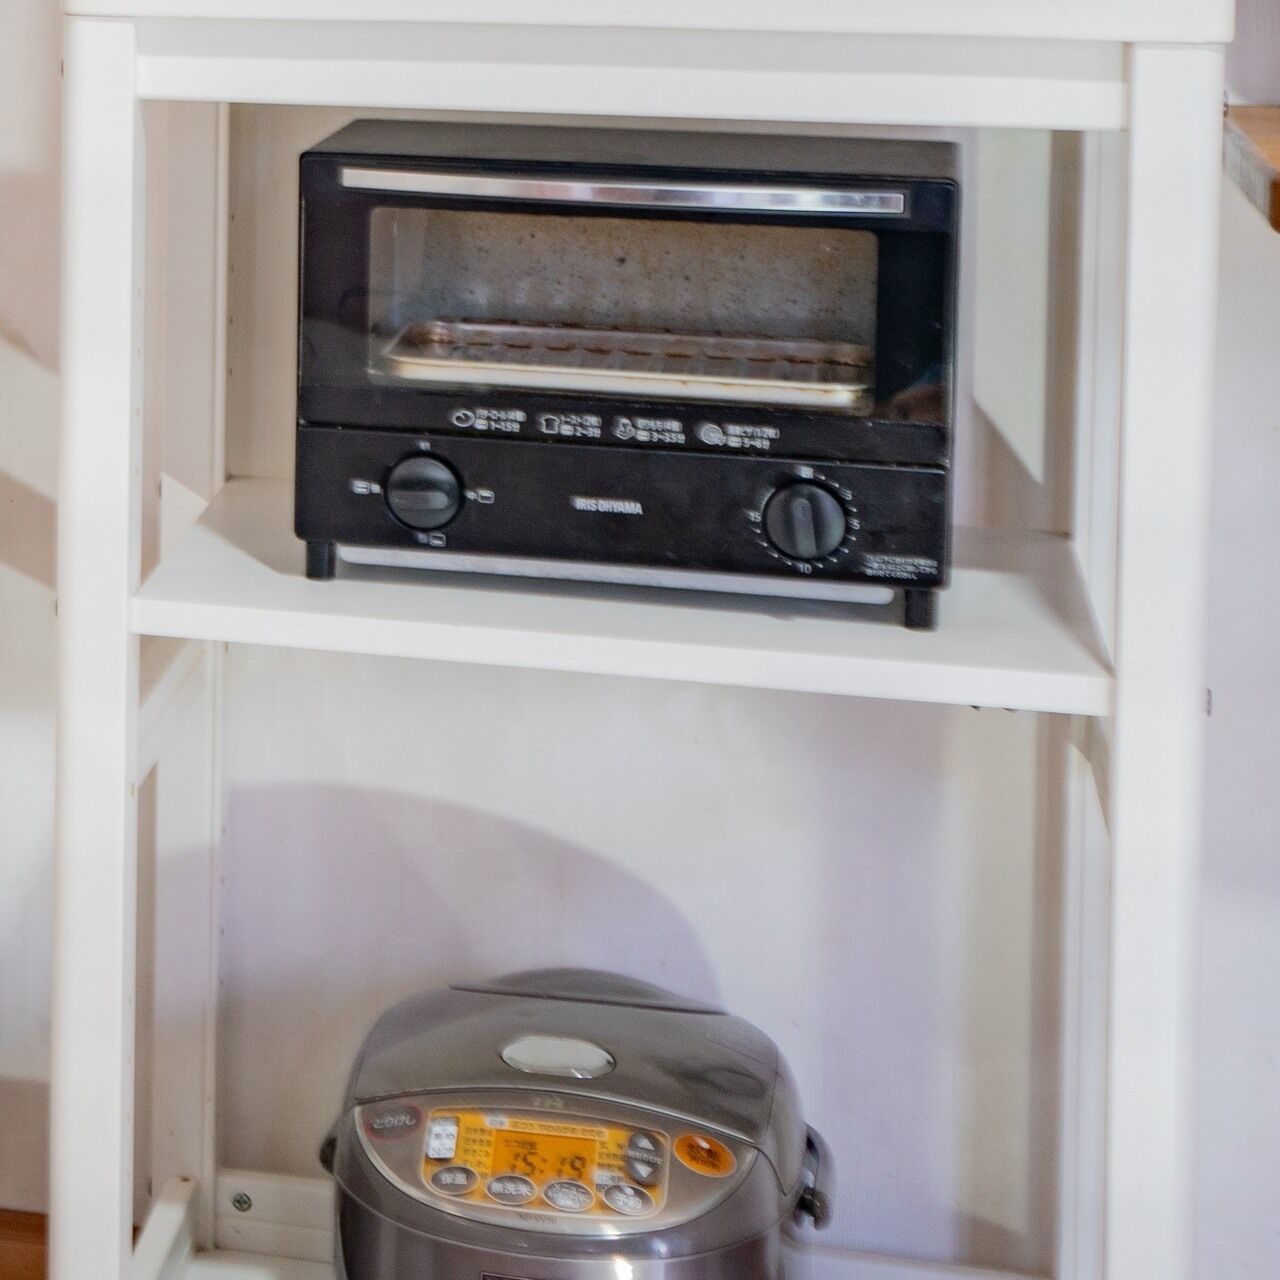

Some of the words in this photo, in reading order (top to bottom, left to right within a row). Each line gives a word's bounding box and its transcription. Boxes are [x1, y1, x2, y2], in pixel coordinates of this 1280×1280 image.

[573, 498, 598, 511] IRIS
[598, 500, 643, 515] OHYAMA
[748, 511, 762, 522] 15
[798, 563, 813, 574] 10
